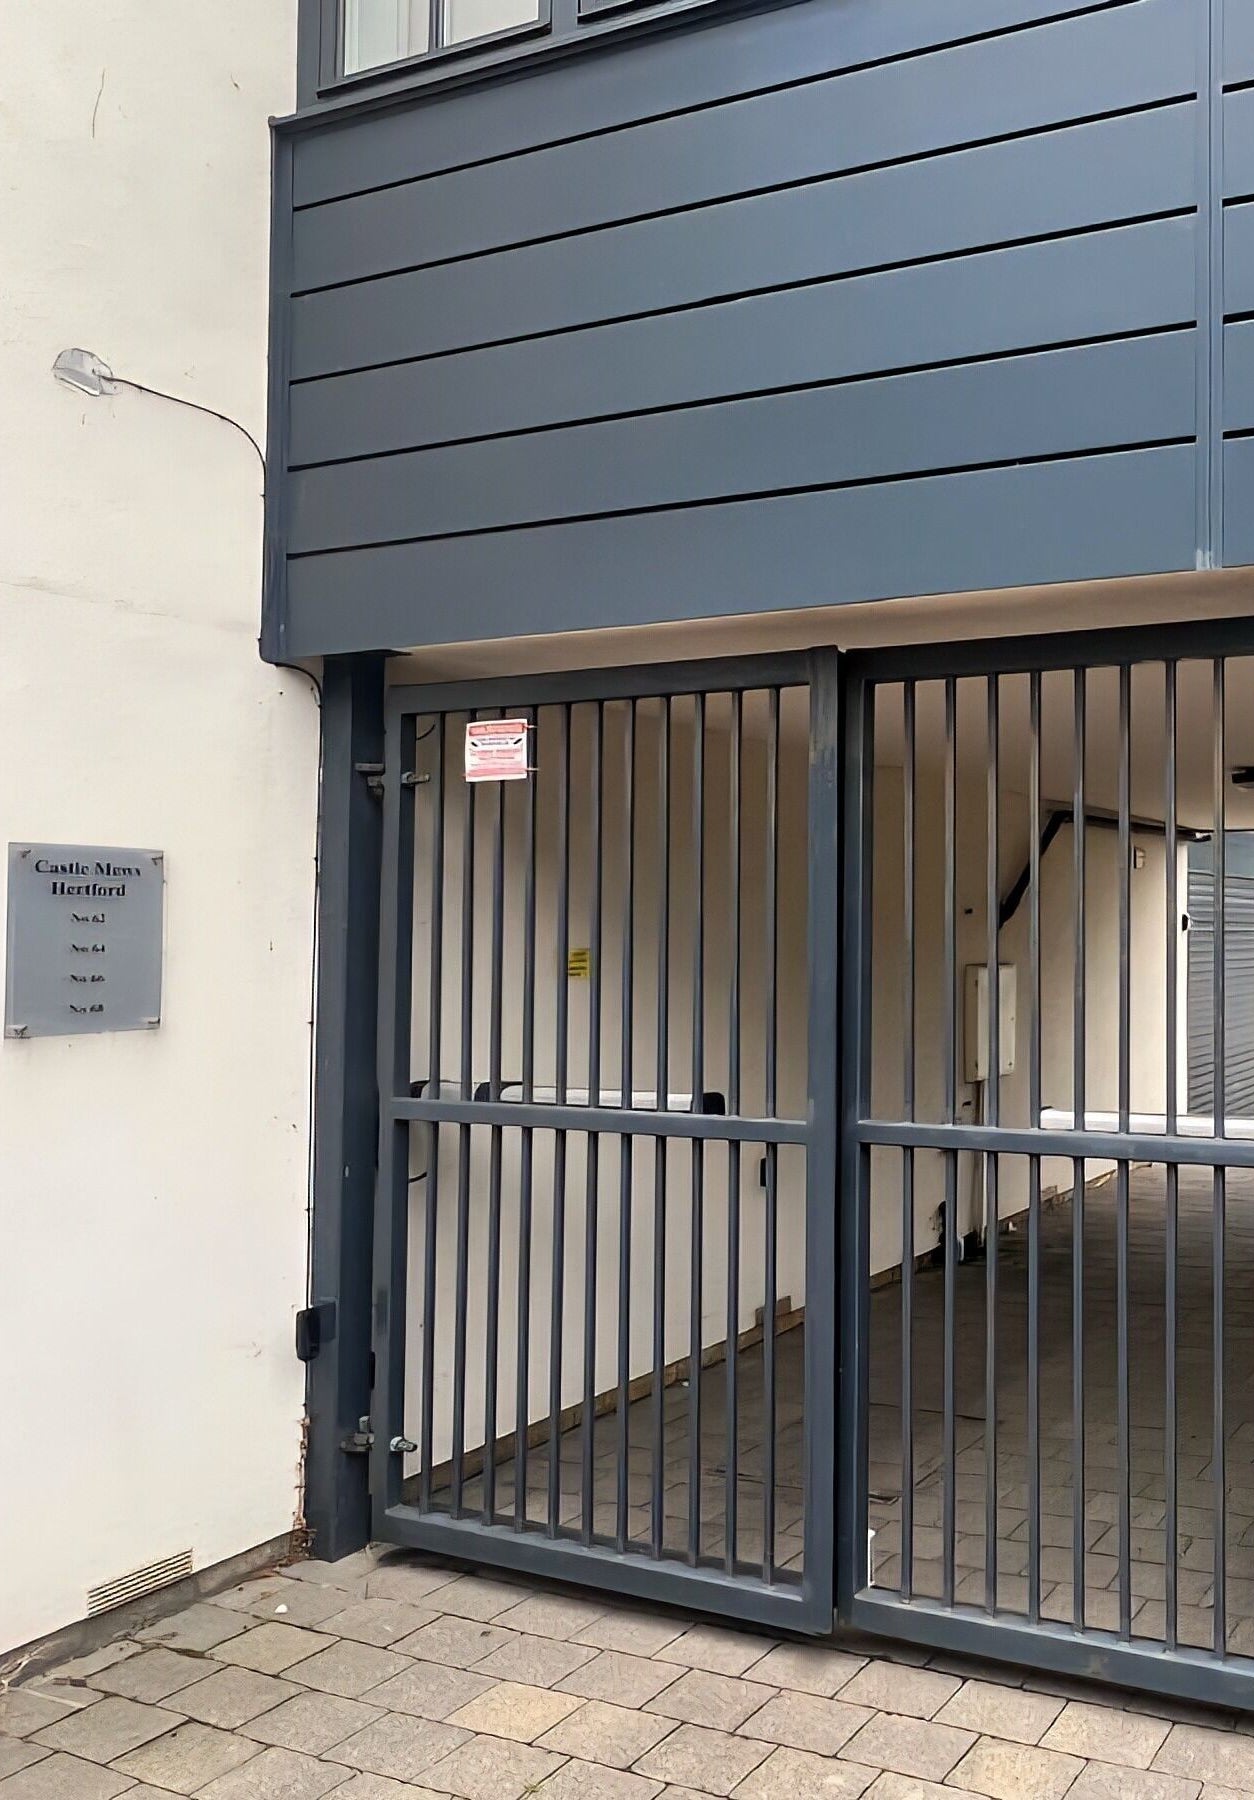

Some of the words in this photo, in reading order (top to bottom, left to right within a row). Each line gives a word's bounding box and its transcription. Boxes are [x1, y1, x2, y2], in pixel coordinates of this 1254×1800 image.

[35, 859, 89, 875] Castle
[95, 862, 141, 877] Mews
[51, 881, 126, 897] Hertford
